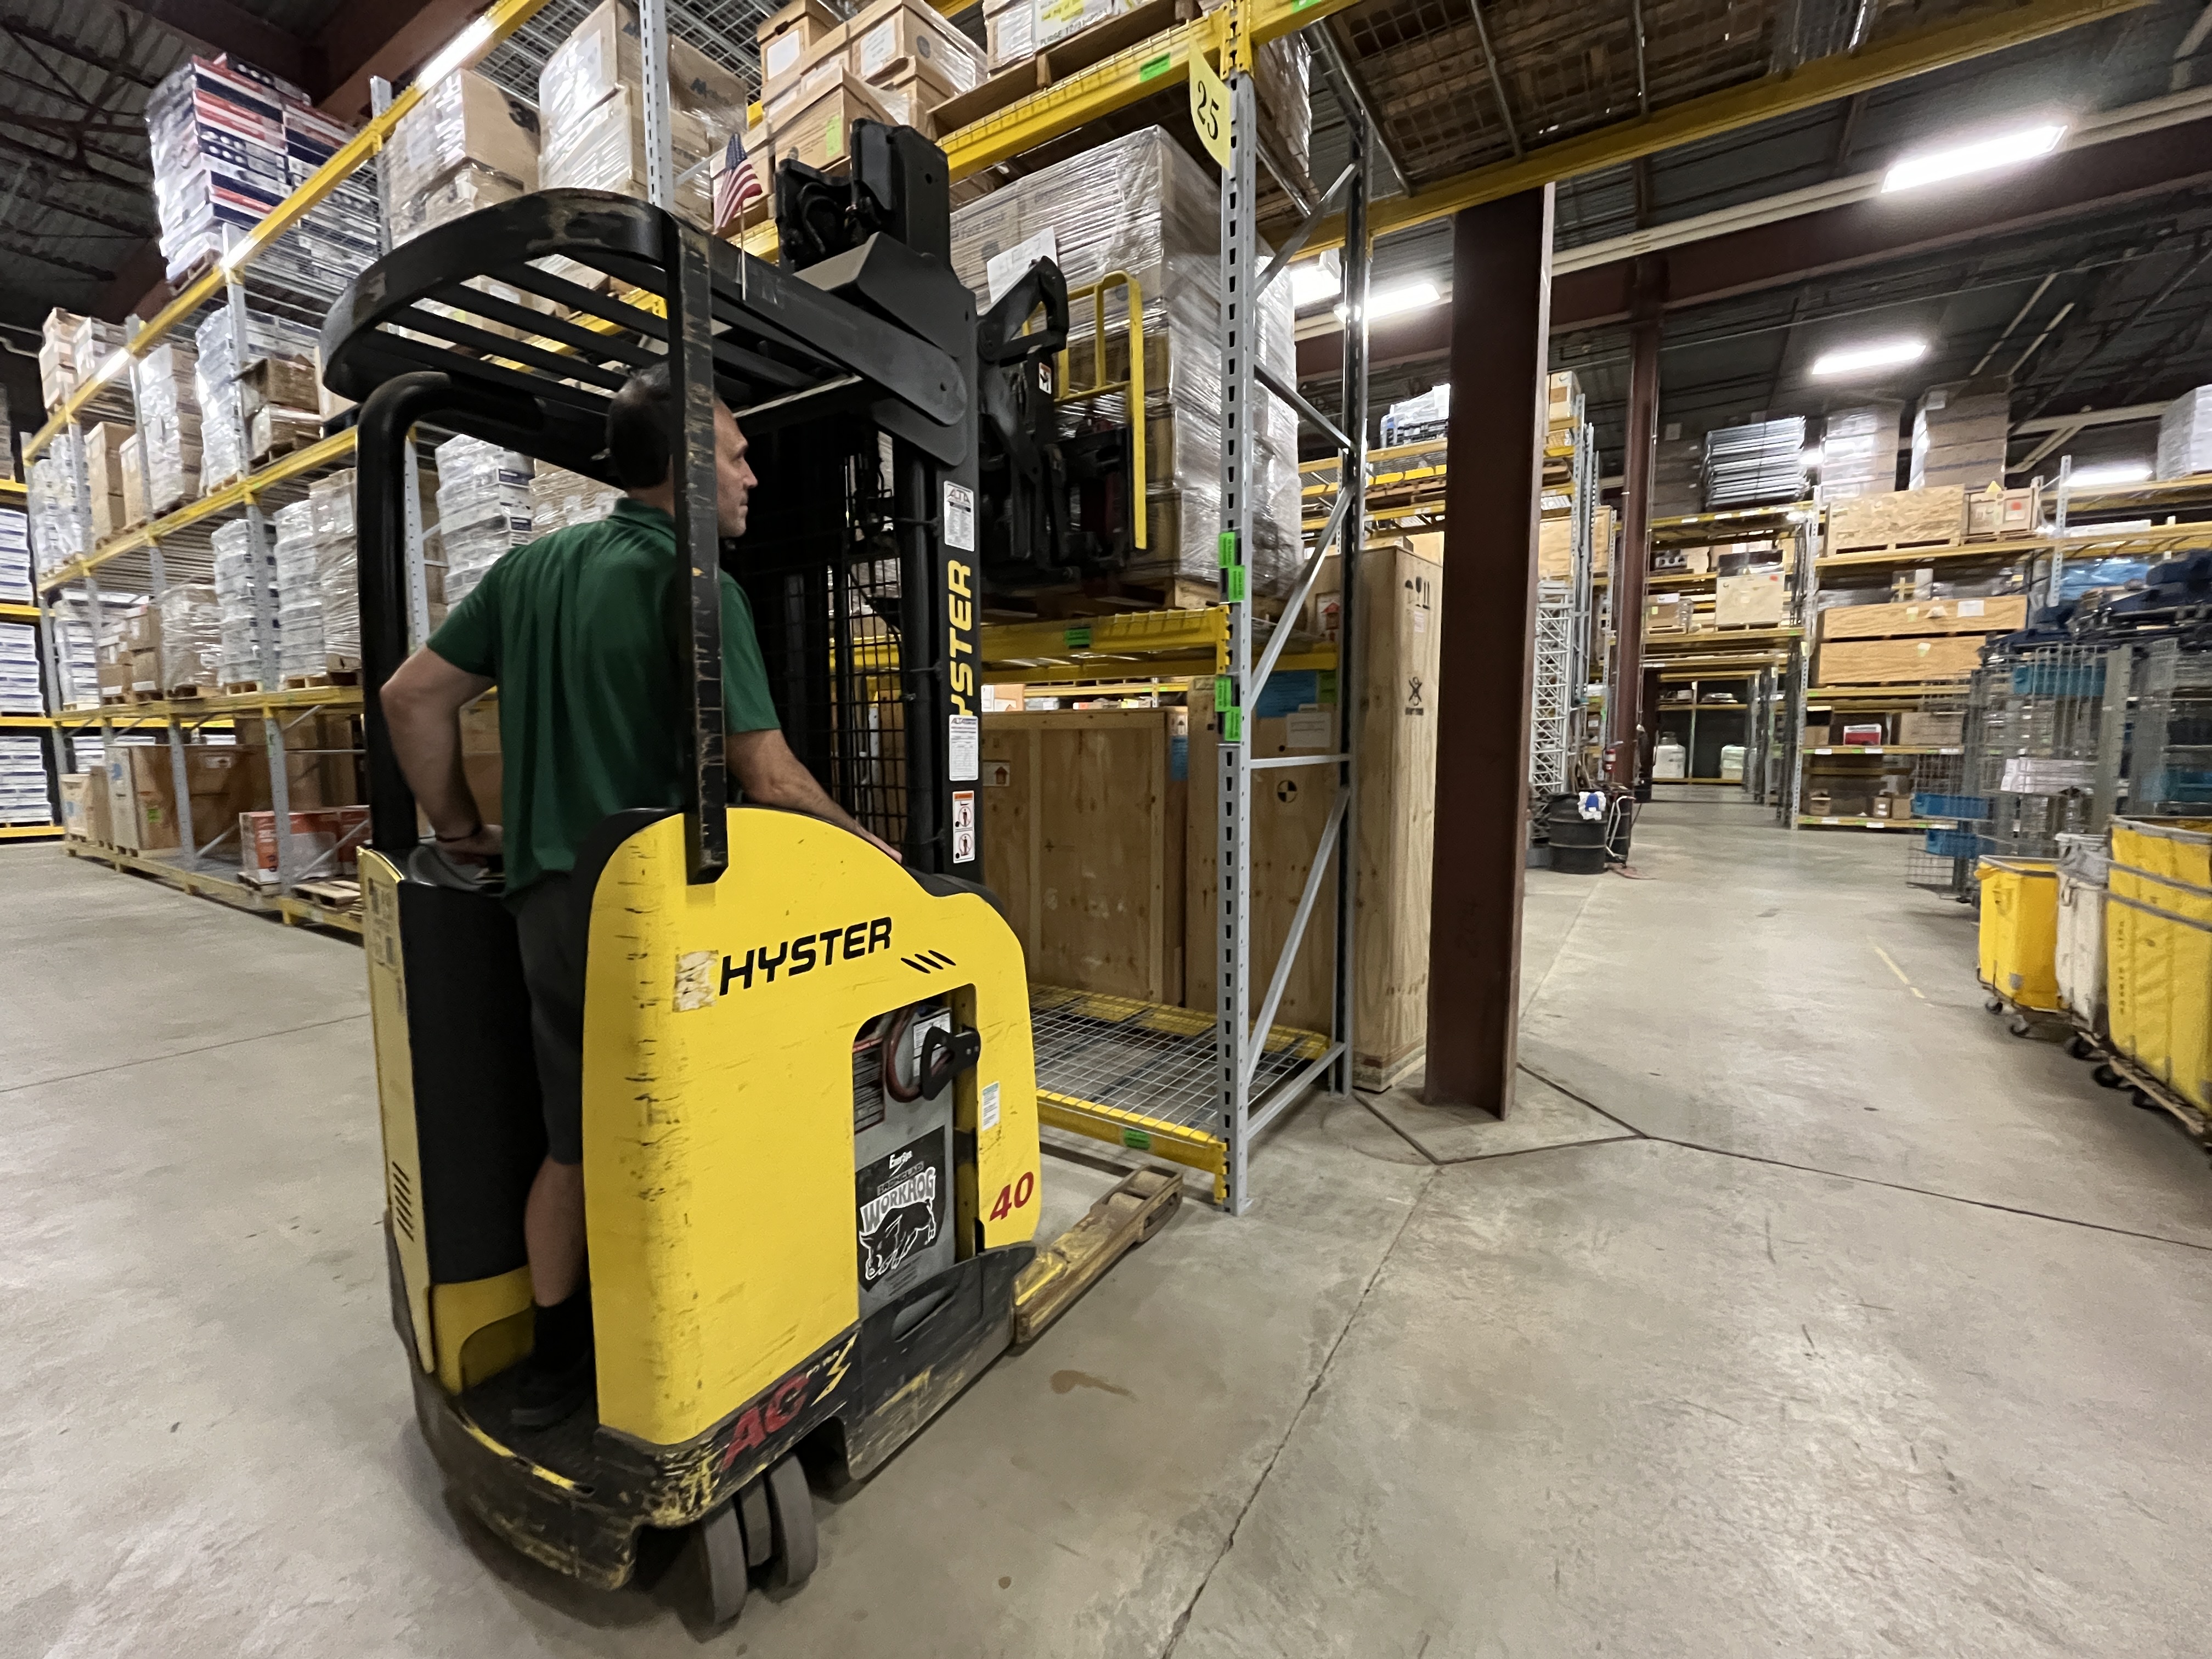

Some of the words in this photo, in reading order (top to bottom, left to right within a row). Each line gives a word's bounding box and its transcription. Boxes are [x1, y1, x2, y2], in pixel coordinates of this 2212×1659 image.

[1197, 80, 1219, 140] 25
[948, 560, 973, 716] YSTER
[719, 917, 892, 996] HYSTER
[860, 1166, 936, 1235] WORKHOG
[878, 1163, 923, 1194] IRONCLAD
[989, 1171, 1034, 1222] 40
[721, 1374, 811, 1472] AC
